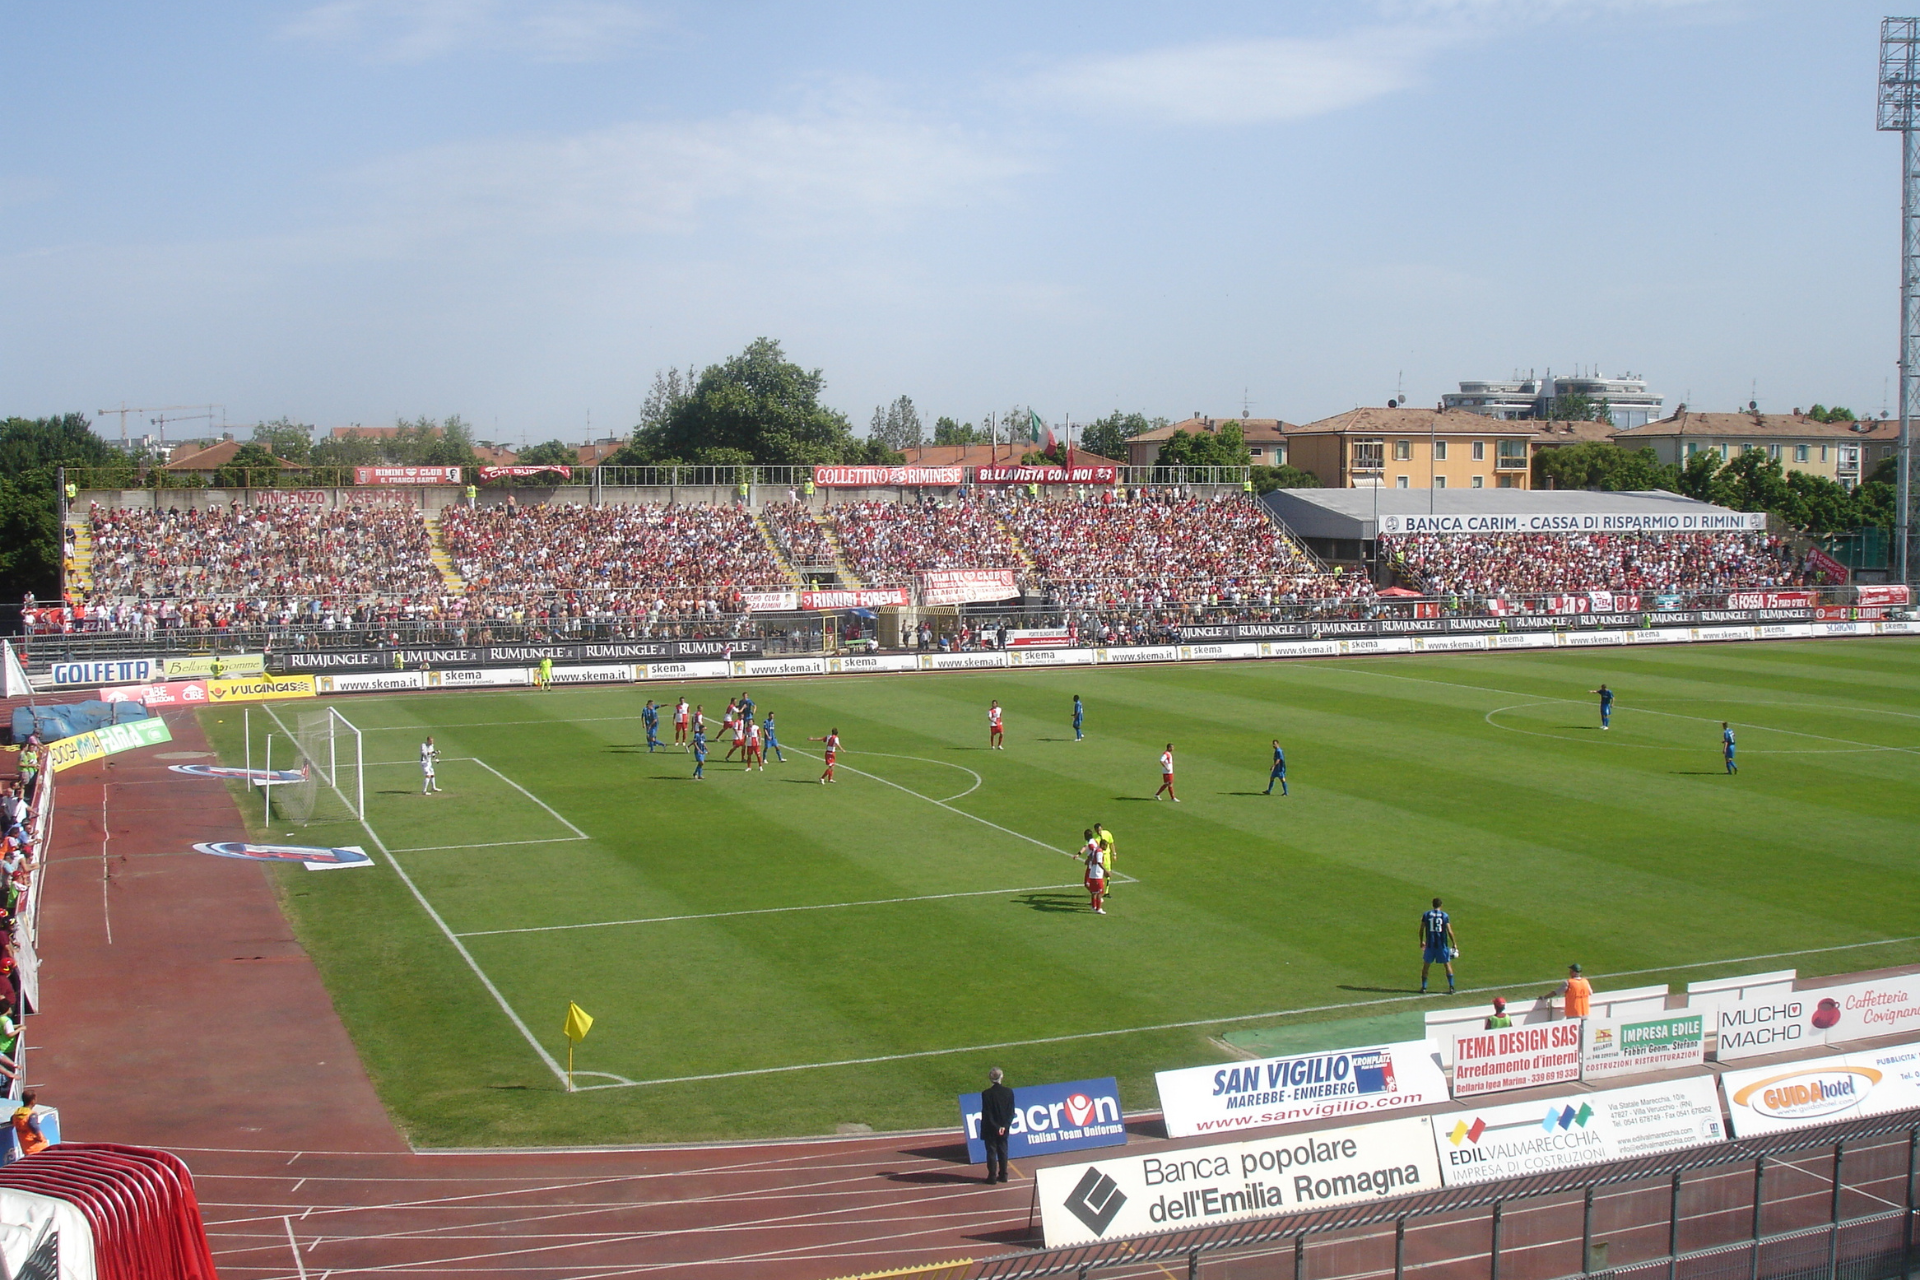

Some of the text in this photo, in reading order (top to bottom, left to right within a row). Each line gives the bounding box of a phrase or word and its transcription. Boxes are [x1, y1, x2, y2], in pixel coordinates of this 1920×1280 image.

[420, 468, 442, 476] CLUB
[816, 468, 960, 484] COLLETTIVO RIMINESE
[980, 469, 1092, 481] BELLAVISTA CON NOI
[256, 491, 326, 504] VINCENZO
[1406, 516, 1744, 531] BANCA CARIM CASSA DI RISPARMIO DI RIMINI
[977, 572, 1000, 580] CLUB
[1739, 594, 1764, 608] FOSSA
[1766, 594, 1778, 608] 75
[1840, 608, 1880, 618] CLIARI
[1570, 636, 1620, 644] www.skema.it
[1637, 630, 1660, 638] skema
[1703, 632, 1748, 640] www.skema.it
[1194, 646, 1222, 654] skema
[1276, 646, 1332, 655] www.skema.it
[1352, 640, 1378, 648] skema
[1428, 640, 1482, 650] www.skema.it
[845, 658, 877, 667] skema
[1025, 651, 1055, 660] skema
[1112, 651, 1172, 661] www.skema.it
[652, 664, 686, 674] skema
[752, 662, 820, 674] www.skema.it
[938, 658, 1003, 668] www.skema.it
[55, 661, 150, 684] GOLFETTA
[446, 670, 482, 681] skema
[552, 670, 626, 682] www.skema.it
[232, 682, 296, 695] VULCANGAS
[340, 676, 418, 690] www.skema.it
[182, 690, 204, 700] CIBE
[1846, 990, 1908, 1010] Caffetteria
[1722, 1002, 1802, 1028] MUCHO
[1624, 1020, 1700, 1043] IMPRESA EDILE
[1721, 1024, 1801, 1050] MACHO
[1458, 1024, 1578, 1060] TEMA DESIGN SAS
[1624, 1044, 1646, 1056] Fabbri
[1648, 1042, 1670, 1054] Geom.
[1672, 1038, 1698, 1050] Stefano
[1352, 1054, 1391, 1067] KRONPLATZ
[1456, 1050, 1578, 1080] Arredamento d'interni
[1586, 1058, 1632, 1072] COSTRUZIONI
[1635, 1050, 1700, 1065] RISTRUTTURAZIONI
[1212, 1055, 1350, 1096] SAN VIGILIO
[1456, 1068, 1578, 1094] Bellaria Igea Marina 339 69 19 338
[1226, 1081, 1356, 1110] MAREBBE ENNEBERG
[1196, 1093, 1423, 1132] www.sanvigilio.com
[1608, 1103, 1618, 1111] Via
[1620, 1100, 1640, 1109] Statale
[1610, 1100, 1693, 1119] 47827 Villa Verucchio (RN)
[1624, 1118, 1638, 1126] 0541
[1665, 1112, 1676, 1120] Fax
[1676, 1110, 1690, 1118] 0541
[1028, 1124, 1123, 1144] Italian Team Uniforms
[1617, 1127, 1694, 1145] www.edilvalmarecchia.com
[1450, 1130, 1602, 1166] EDILVALMARECCHIA
[1143, 1138, 1358, 1186] Banca popolare
[1452, 1147, 1606, 1181] IMPRESA DI COSTRUZIONI
[1150, 1164, 1420, 1223] dell'Emilia Romagna
